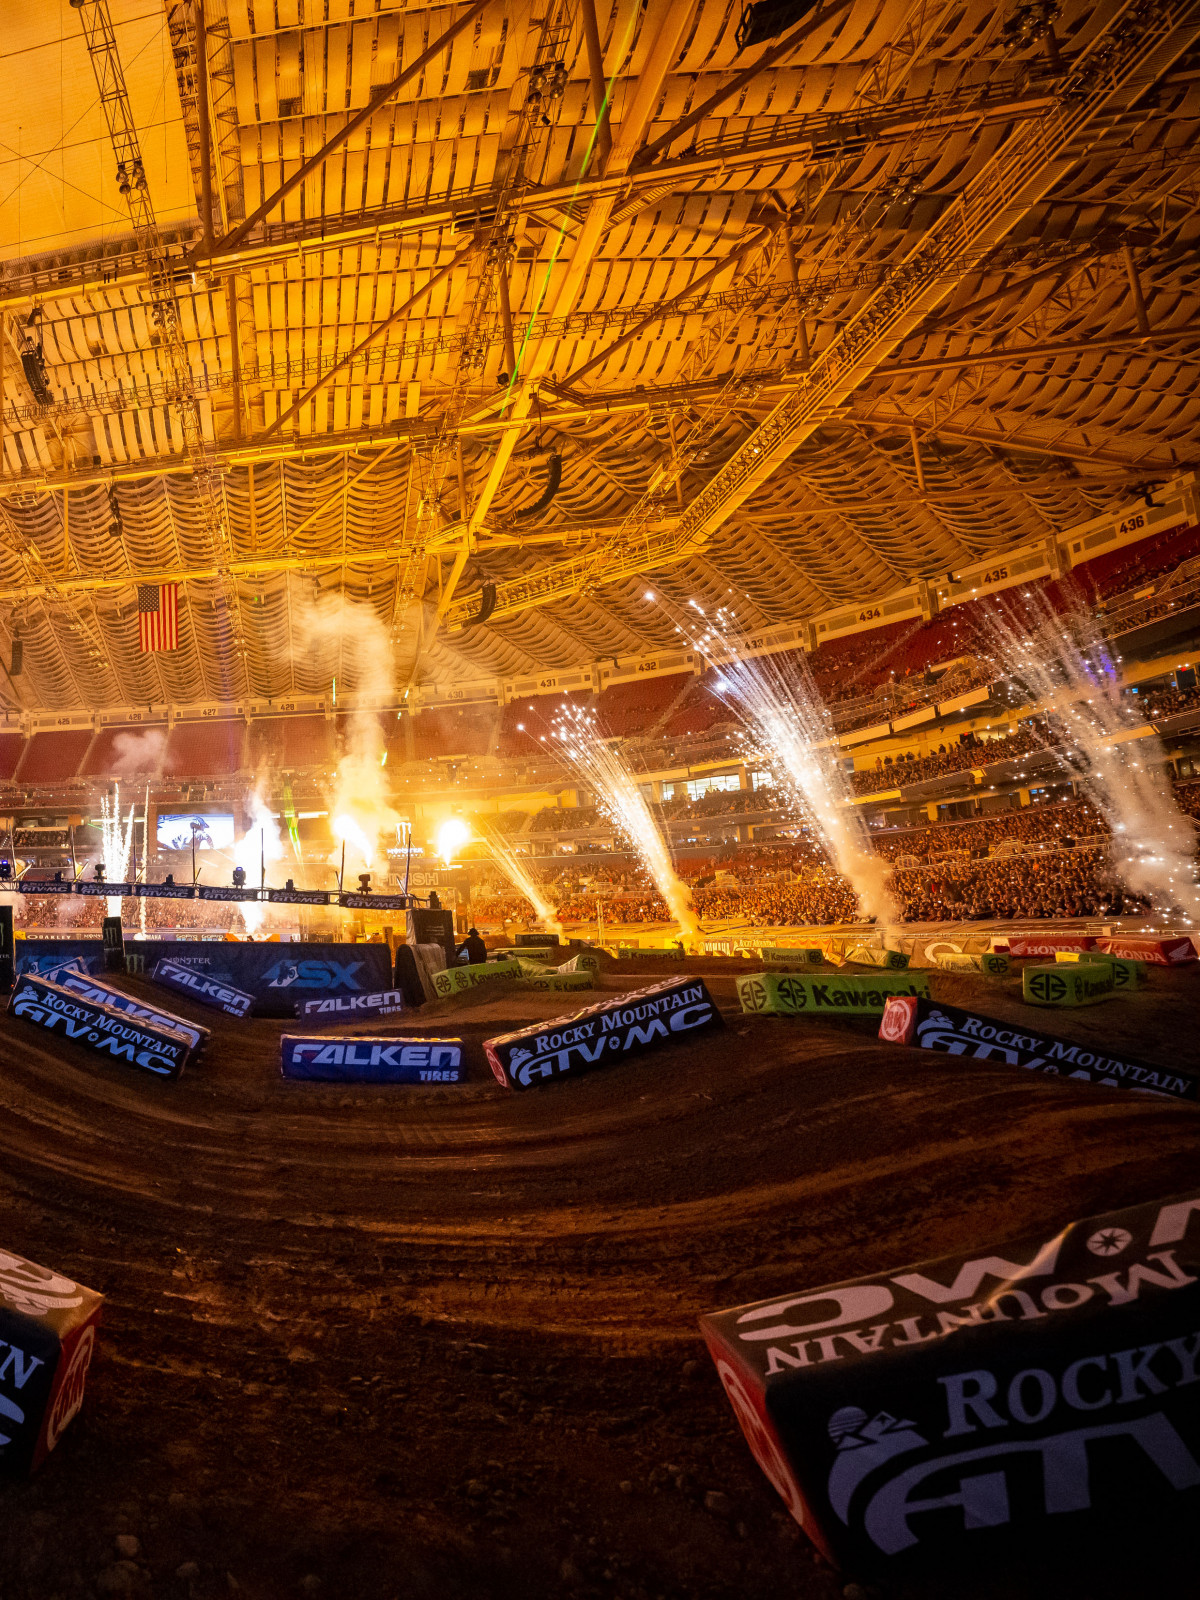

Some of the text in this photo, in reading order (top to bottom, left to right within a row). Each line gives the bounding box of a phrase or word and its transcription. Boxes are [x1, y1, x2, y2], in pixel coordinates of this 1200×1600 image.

[1118, 514, 1146, 534] 436
[983, 567, 1009, 585] 435
[858, 606, 882, 622] 434
[637, 661, 658, 672] 432
[539, 677, 557, 688] 431
[447, 689, 464, 699] 430
[202, 707, 217, 716] 427
[280, 703, 296, 711] 428
[770, 952, 806, 963] Kawasaki
[1027, 946, 1083, 954] HONDA
[1115, 950, 1166, 963] HONDA
[469, 965, 523, 986] Kawasaki
[160, 964, 251, 1011] FALKEN
[305, 991, 401, 1014] FALKEN
[41, 992, 182, 1058] ROCKY MOUNTAIN
[535, 1021, 596, 1055] ROCKY
[600, 985, 704, 1032] MOUNTAIN
[292, 1043, 462, 1066] FALKEN
[959, 1016, 1045, 1053] ROCKY
[1046, 1041, 1192, 1094] MOUNTAIN
[419, 1070, 459, 1082] TIRES
[765, 1249, 1199, 1376] MOUNTAIN
[937, 1330, 1200, 1439] ROCKY
